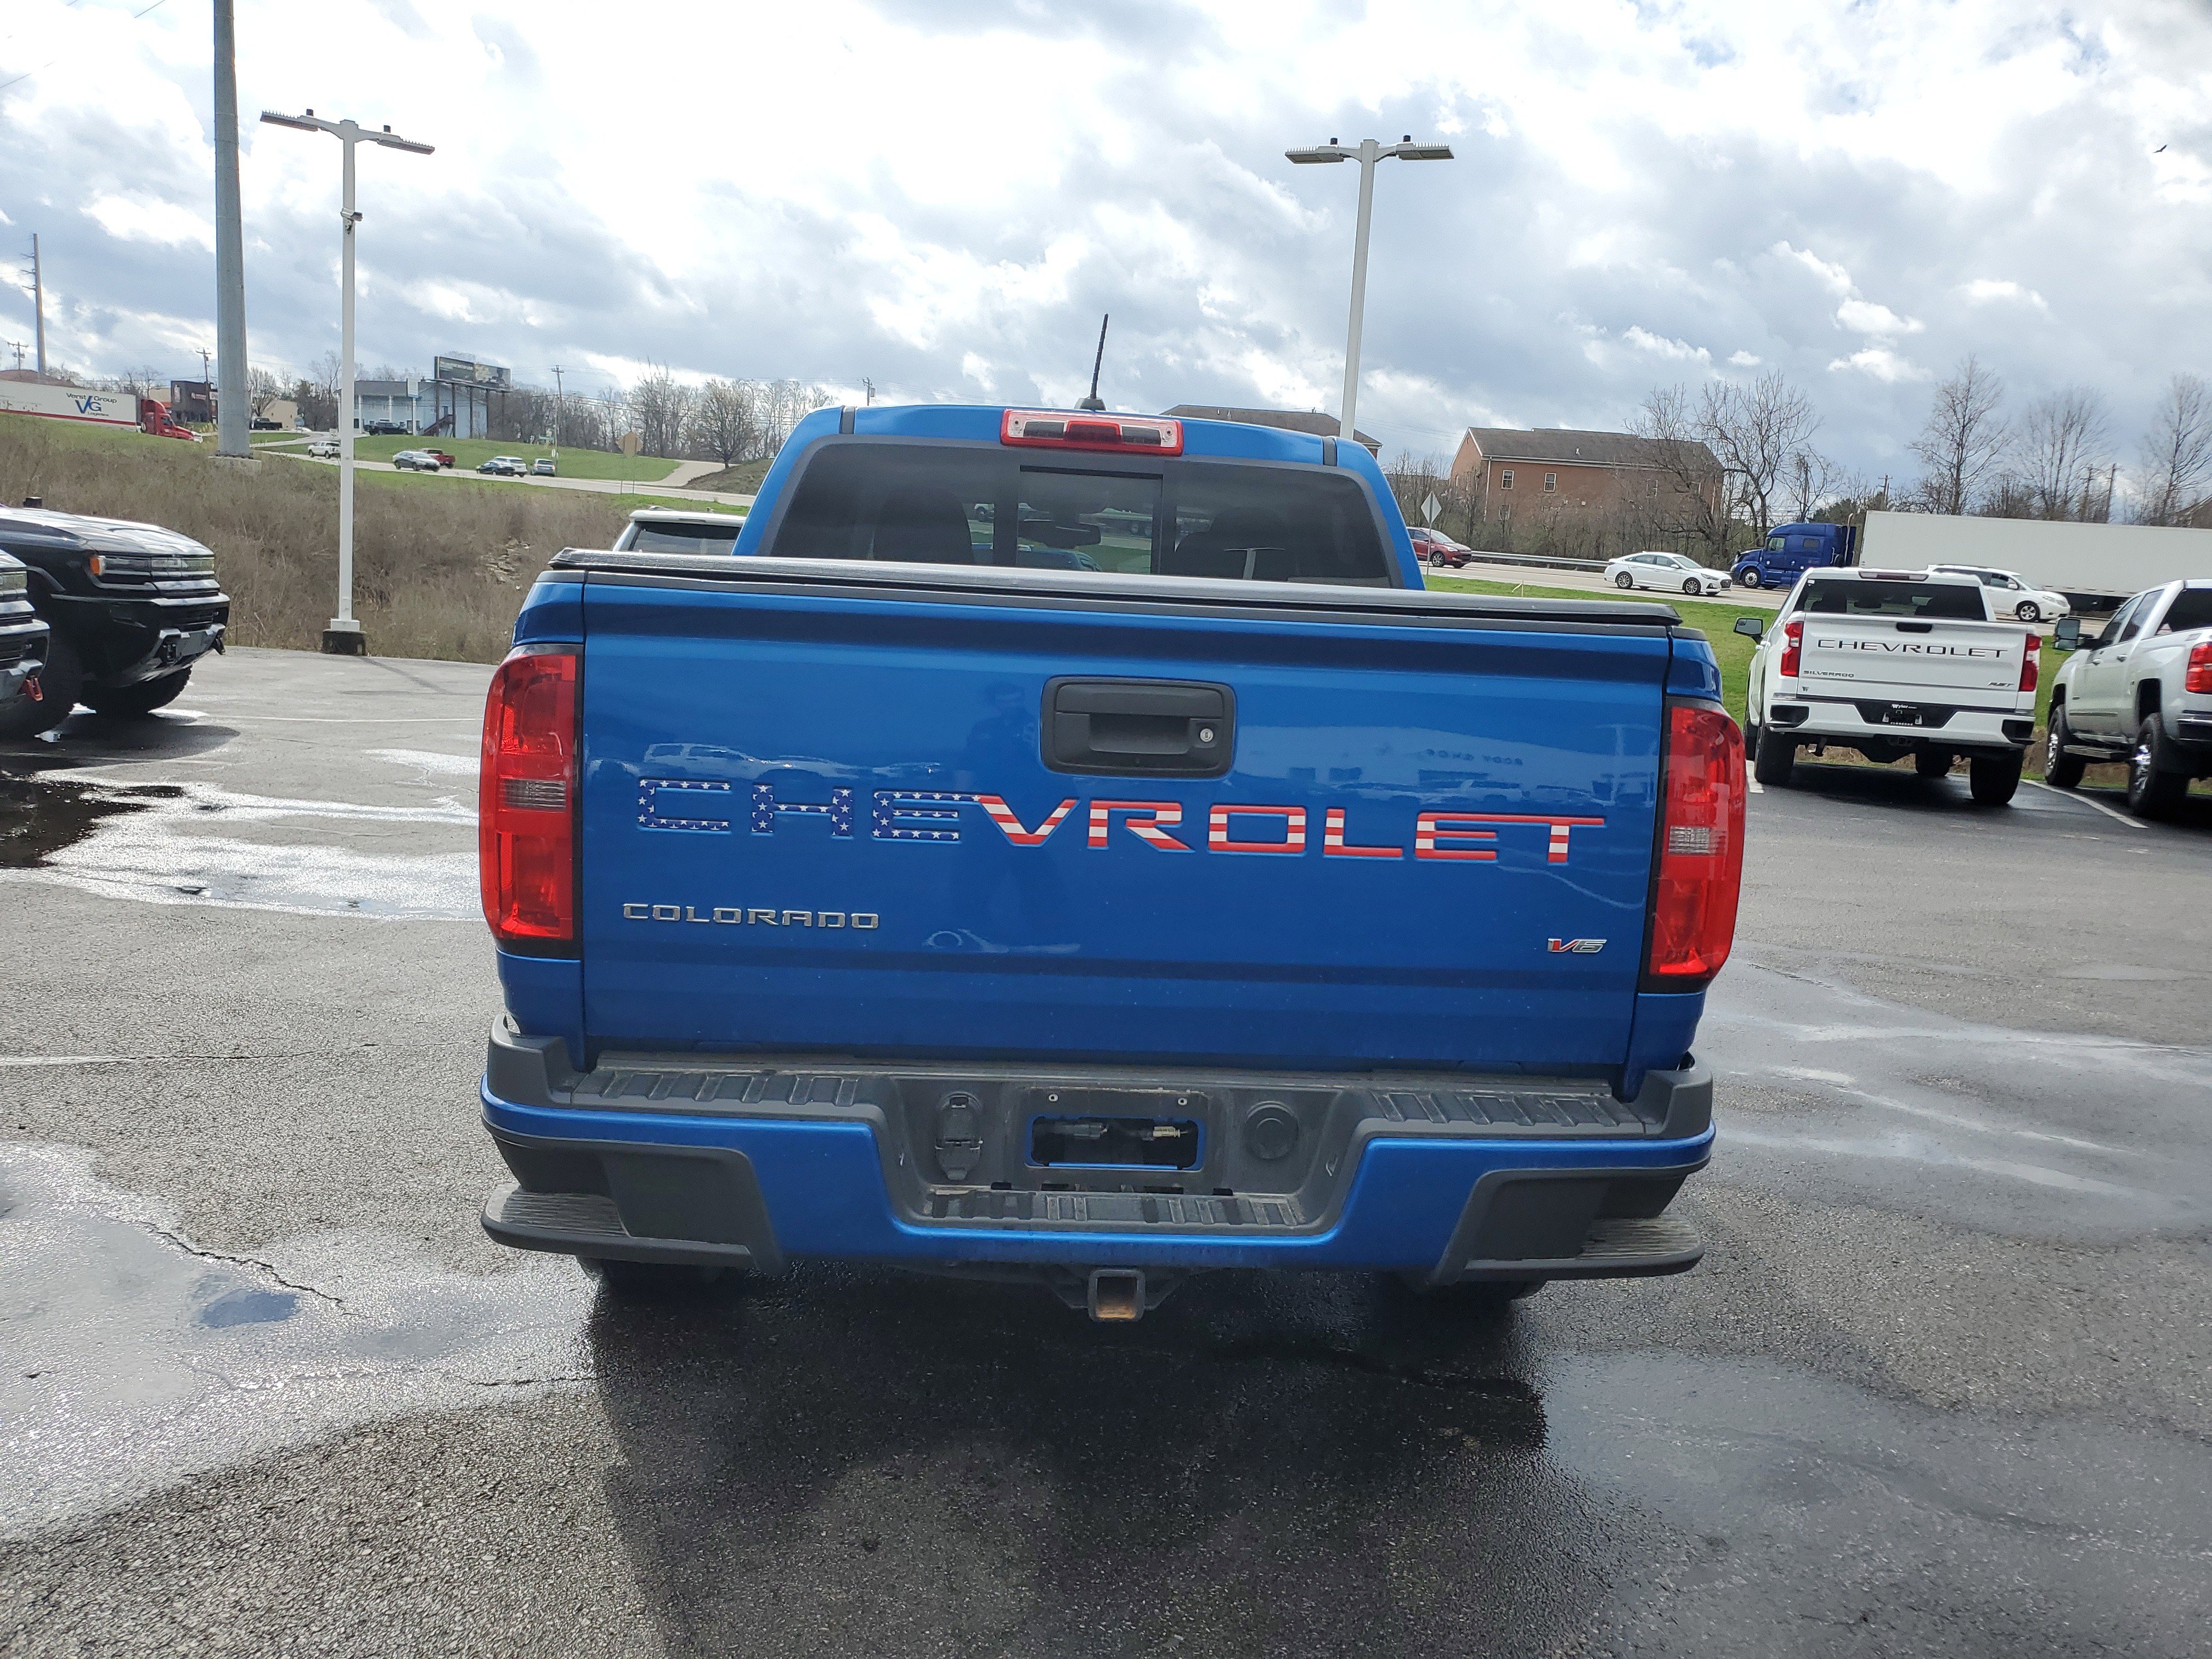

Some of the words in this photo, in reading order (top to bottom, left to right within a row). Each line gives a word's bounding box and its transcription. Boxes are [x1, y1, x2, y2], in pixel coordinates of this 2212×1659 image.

[94, 396, 117, 404] Group
[1818, 639, 2008, 658] CHEVROLET
[1803, 670, 1855, 678] SILVERADO
[637, 777, 1606, 864] CHEVROLET
[623, 902, 879, 929] COLORADO
[1547, 938, 1608, 953] V6
